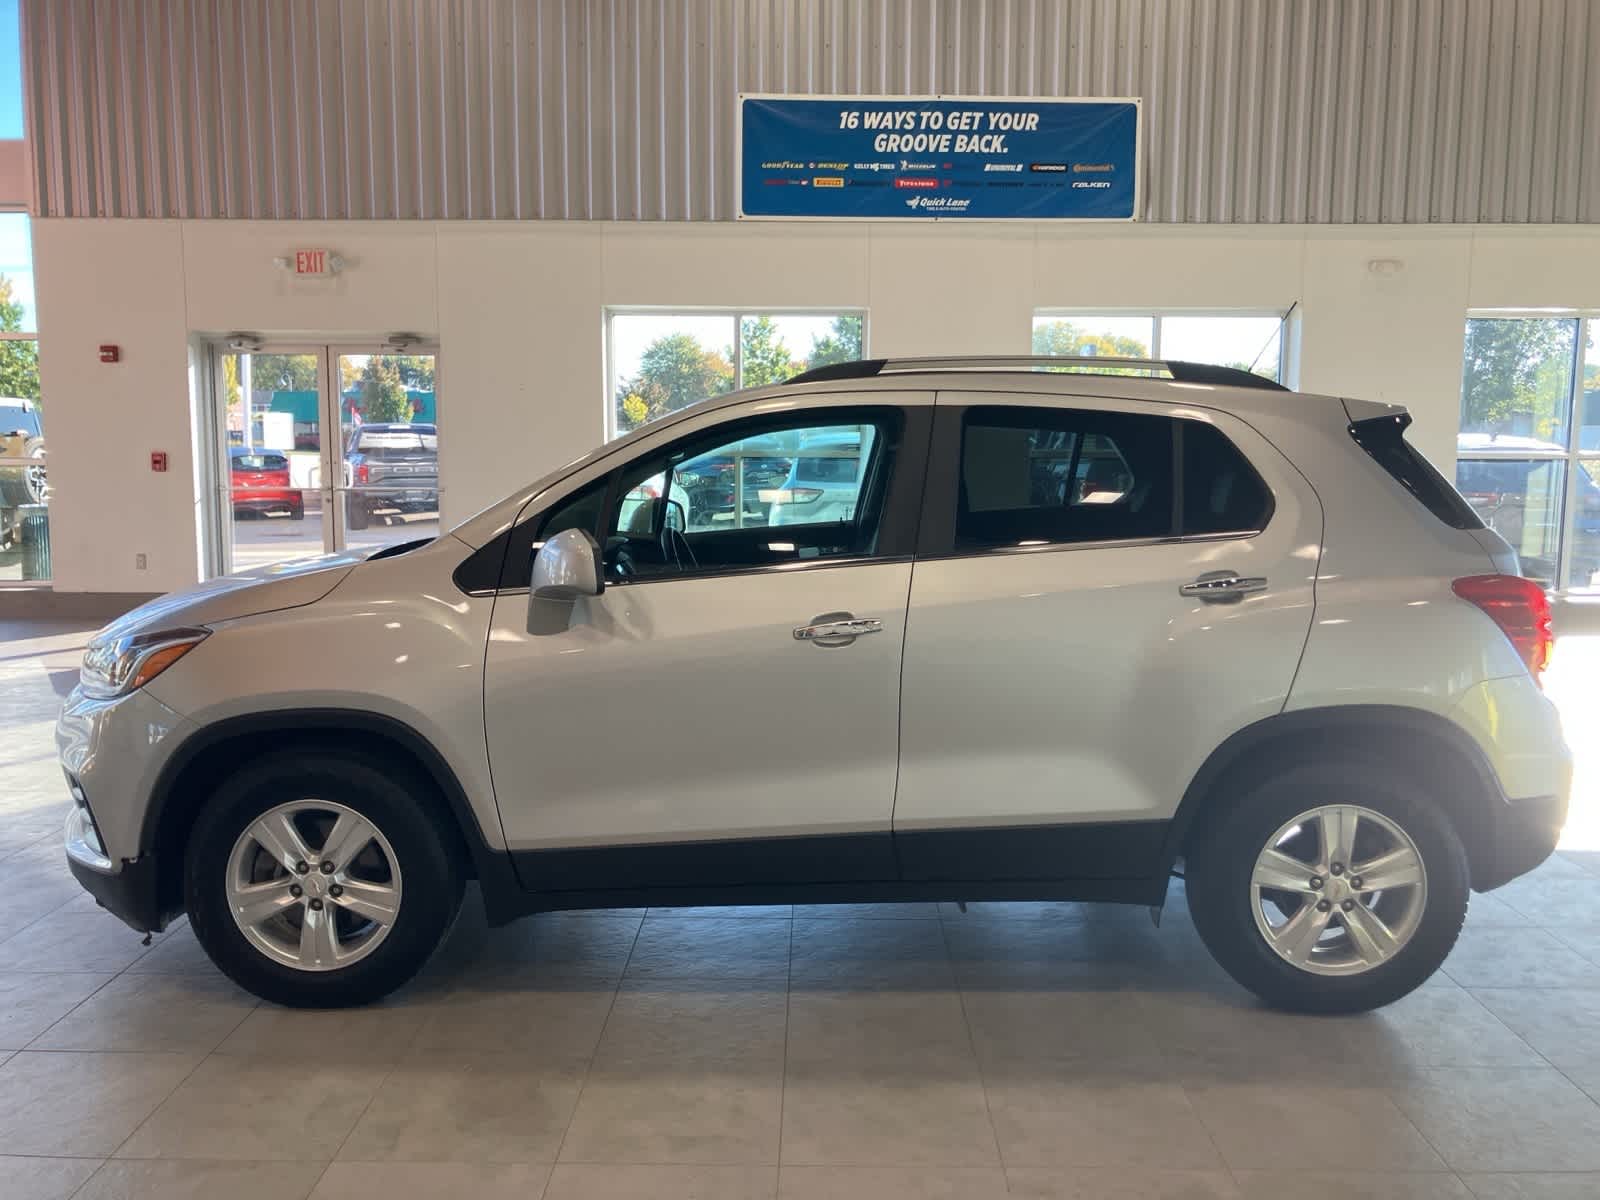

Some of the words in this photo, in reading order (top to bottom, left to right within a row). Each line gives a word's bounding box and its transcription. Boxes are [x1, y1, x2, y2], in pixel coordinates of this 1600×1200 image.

[839, 111, 859, 129] 16
[863, 111, 916, 130] WAYS
[920, 112, 944, 130] TO
[946, 112, 983, 130] GET
[988, 113, 1039, 131] YOUR
[874, 134, 951, 153] GROOVE
[954, 134, 1009, 153] BACK.
[920, 197, 946, 207] Quick
[946, 197, 971, 207] Lane
[296, 250, 326, 273] EXIT
[370, 466, 438, 475] FOR
